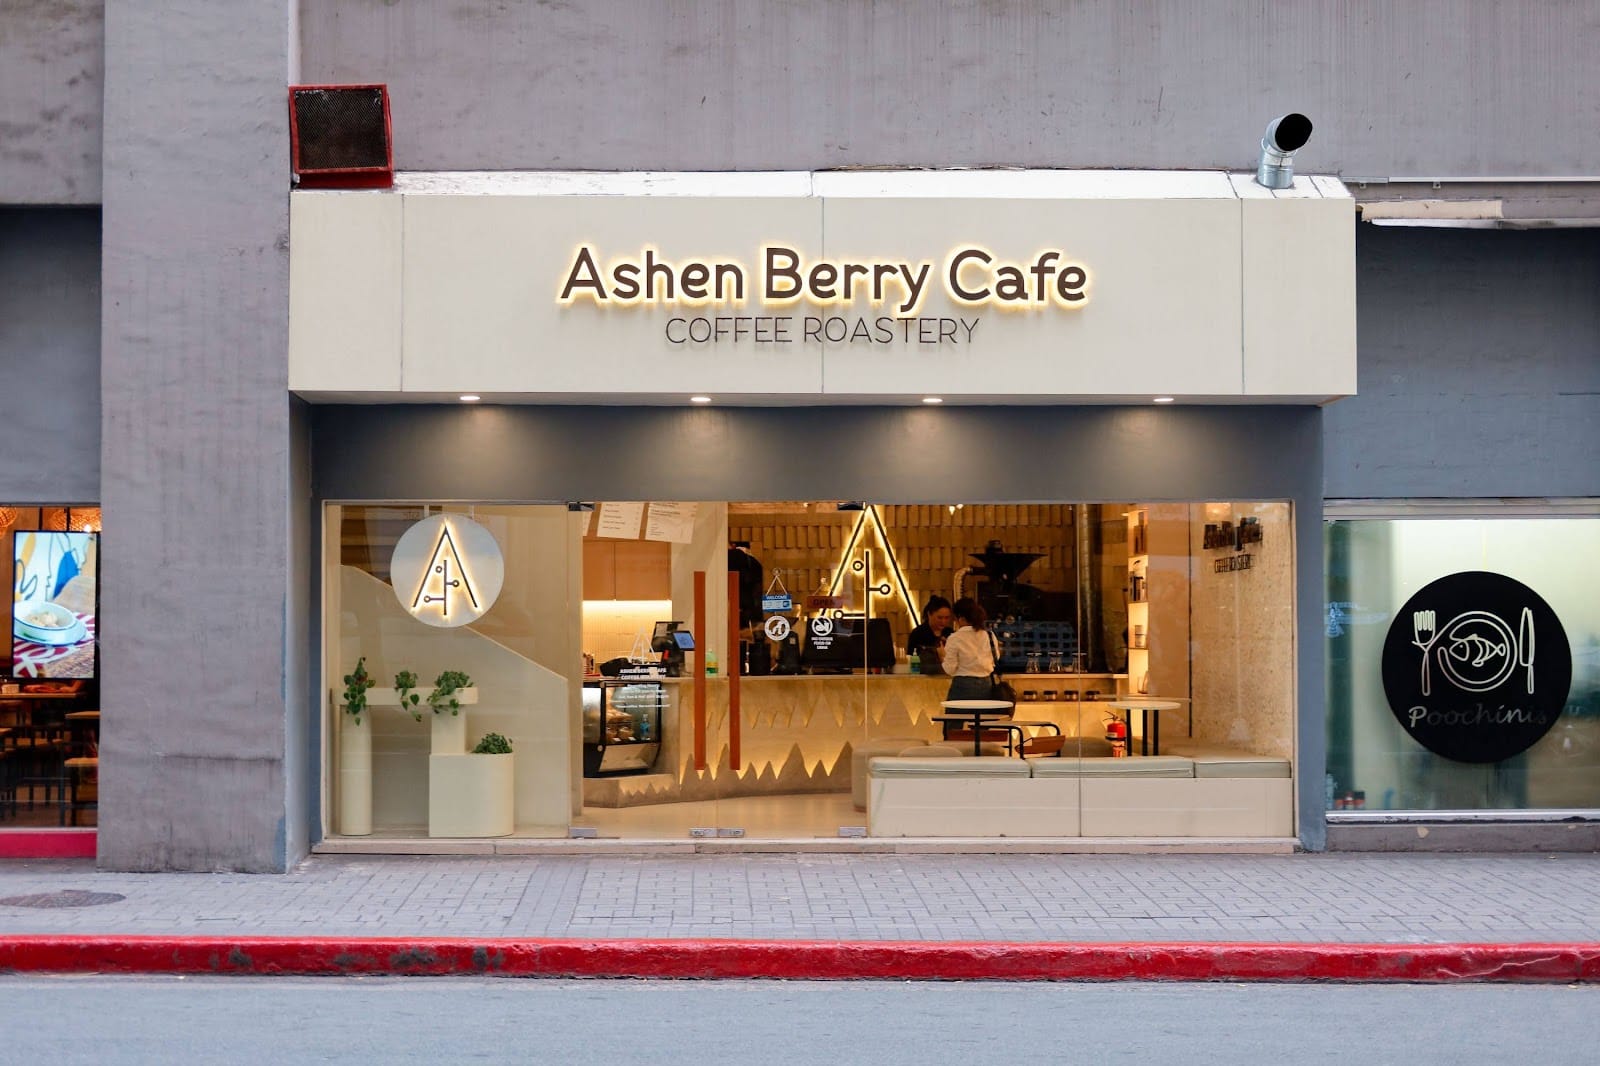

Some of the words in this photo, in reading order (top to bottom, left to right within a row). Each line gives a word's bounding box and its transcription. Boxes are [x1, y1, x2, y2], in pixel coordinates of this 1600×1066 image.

[560, 247, 744, 299] Ashen
[765, 247, 930, 313] Berry
[949, 249, 1087, 302] Cafe
[665, 317, 793, 344] COFFEE
[804, 317, 980, 344] ROASTERY
